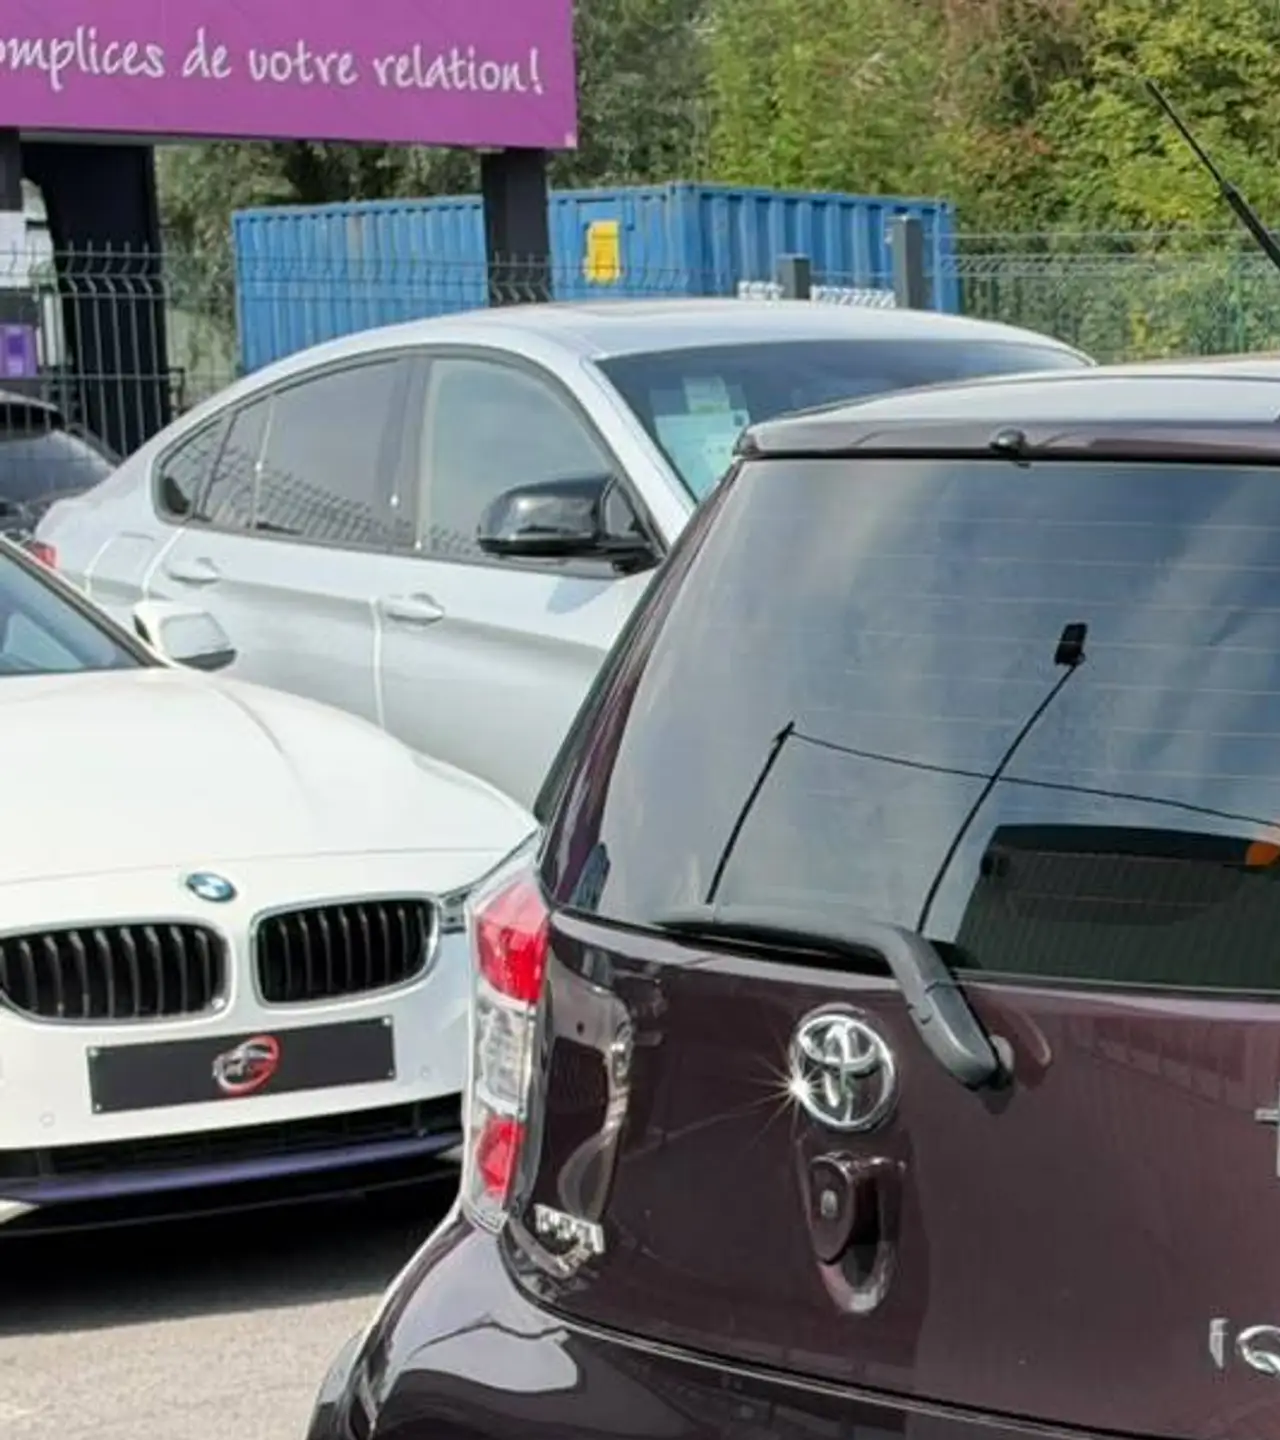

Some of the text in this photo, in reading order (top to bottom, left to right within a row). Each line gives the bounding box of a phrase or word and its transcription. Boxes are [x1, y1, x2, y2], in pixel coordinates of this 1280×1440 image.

[0, 25, 544, 96] mplices de votre relation!
